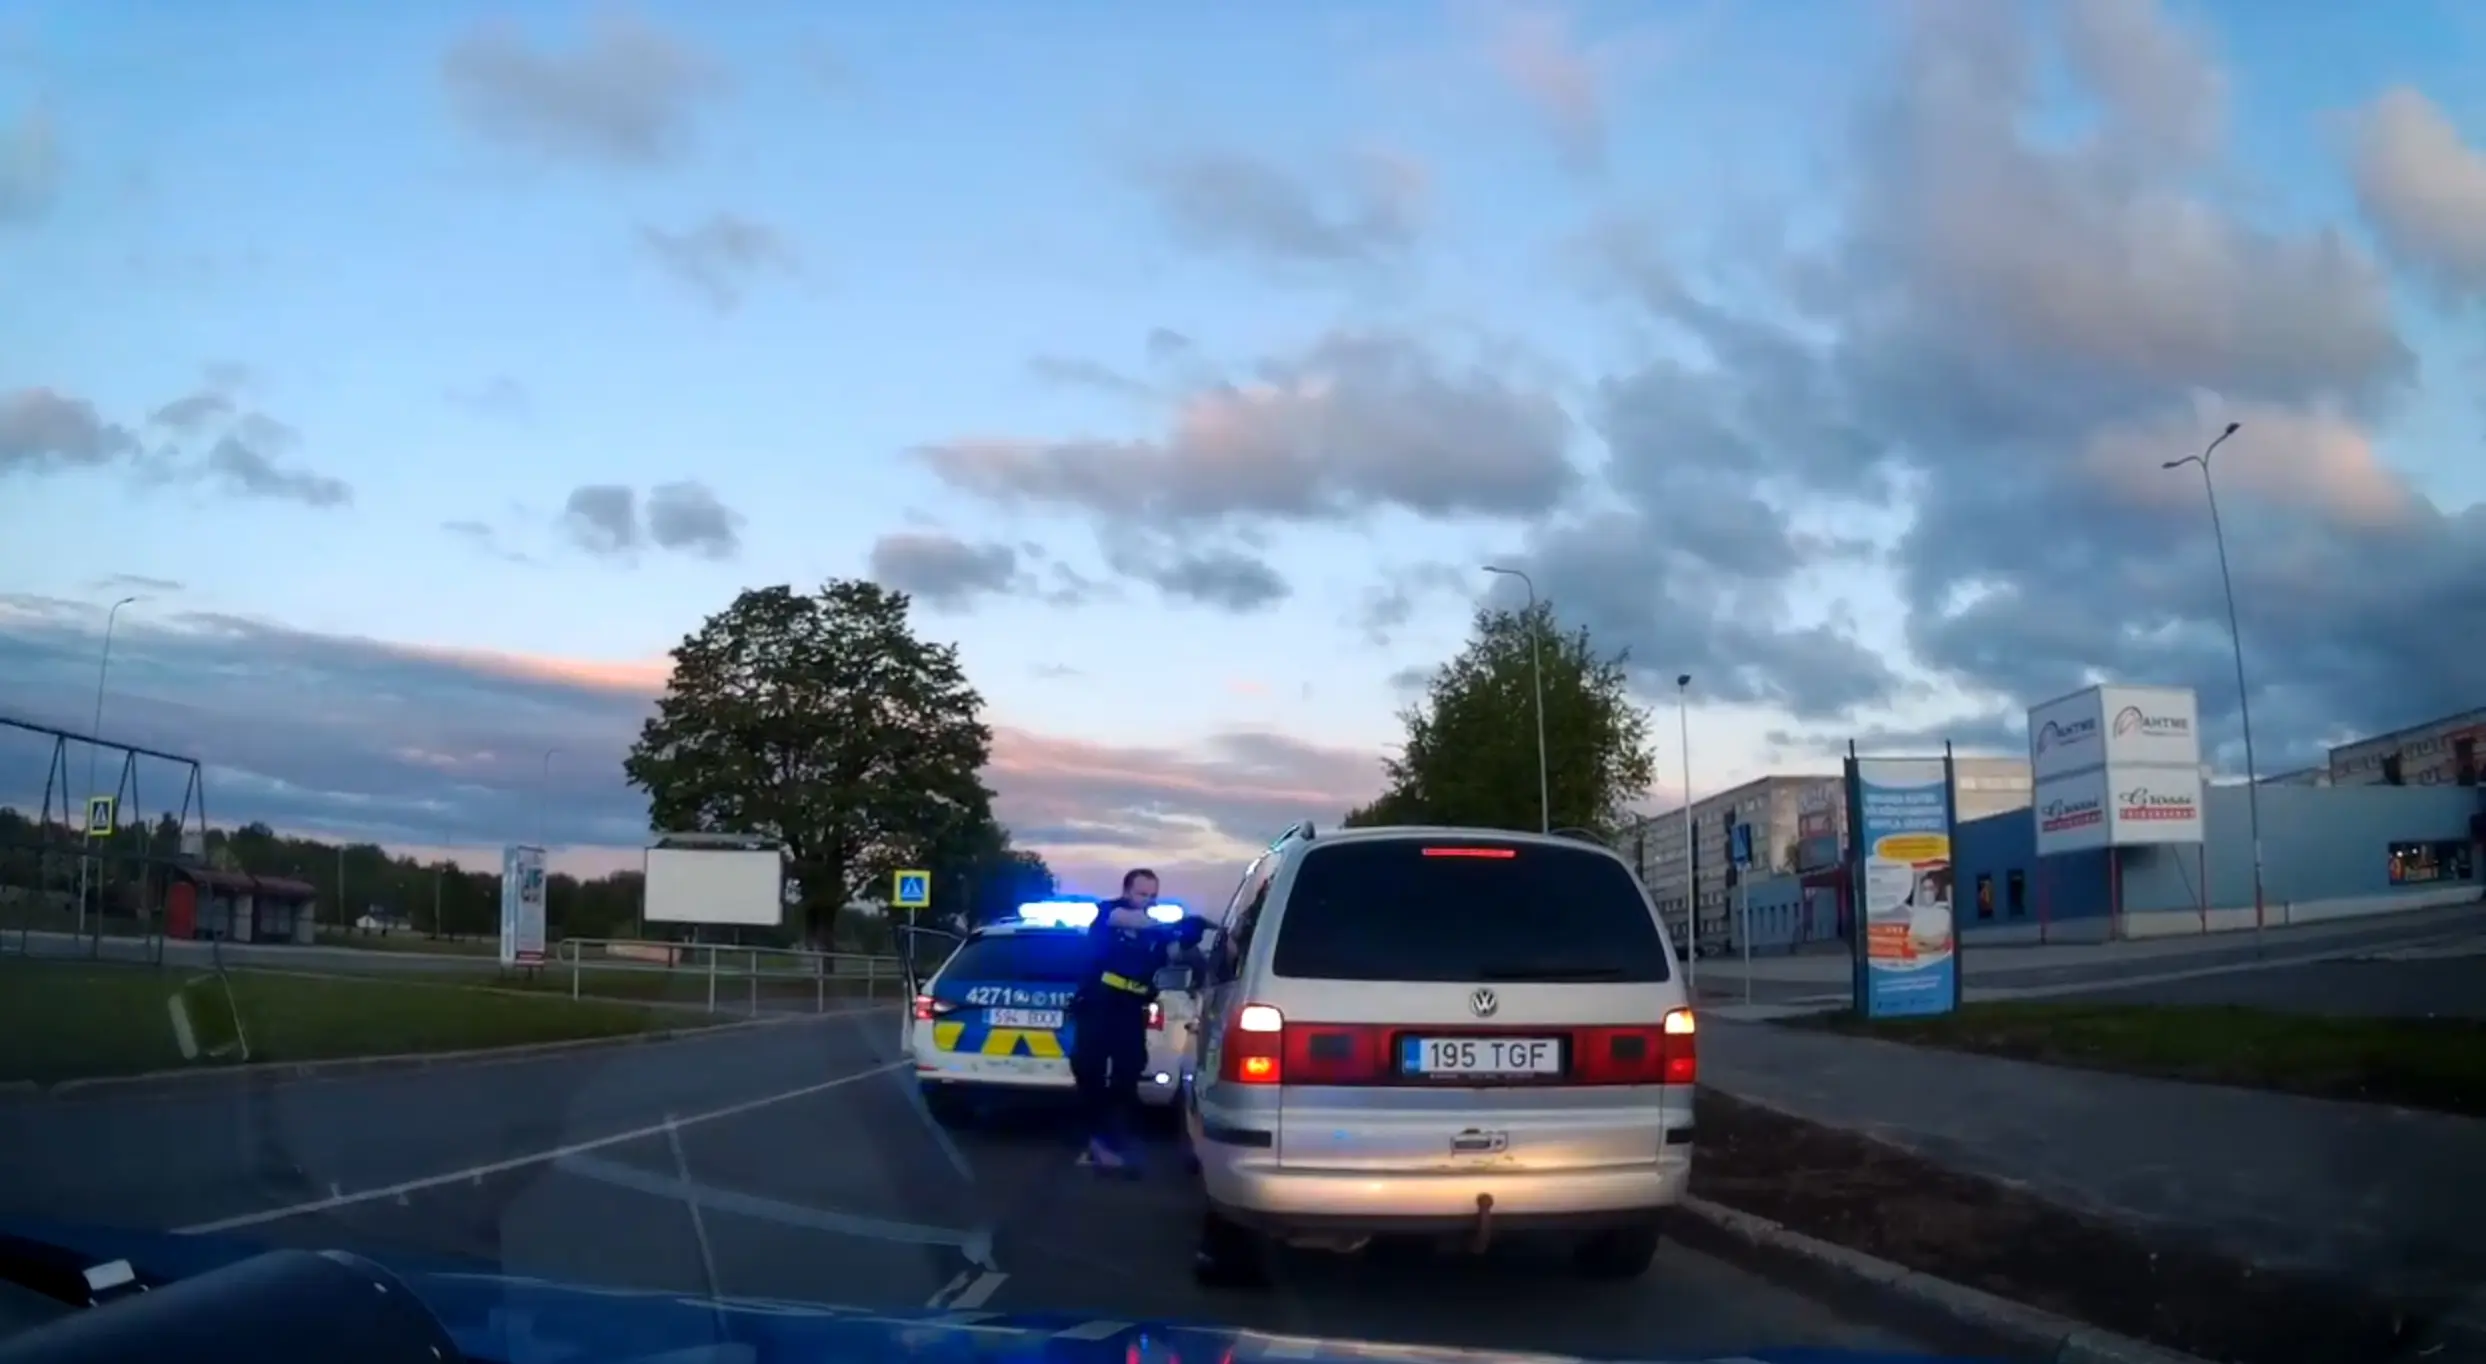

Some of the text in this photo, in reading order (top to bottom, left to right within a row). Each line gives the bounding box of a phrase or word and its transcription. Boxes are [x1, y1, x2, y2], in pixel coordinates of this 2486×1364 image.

[966, 986, 1012, 1005] 4271
[1430, 1042, 1548, 1069] 195 TGF
